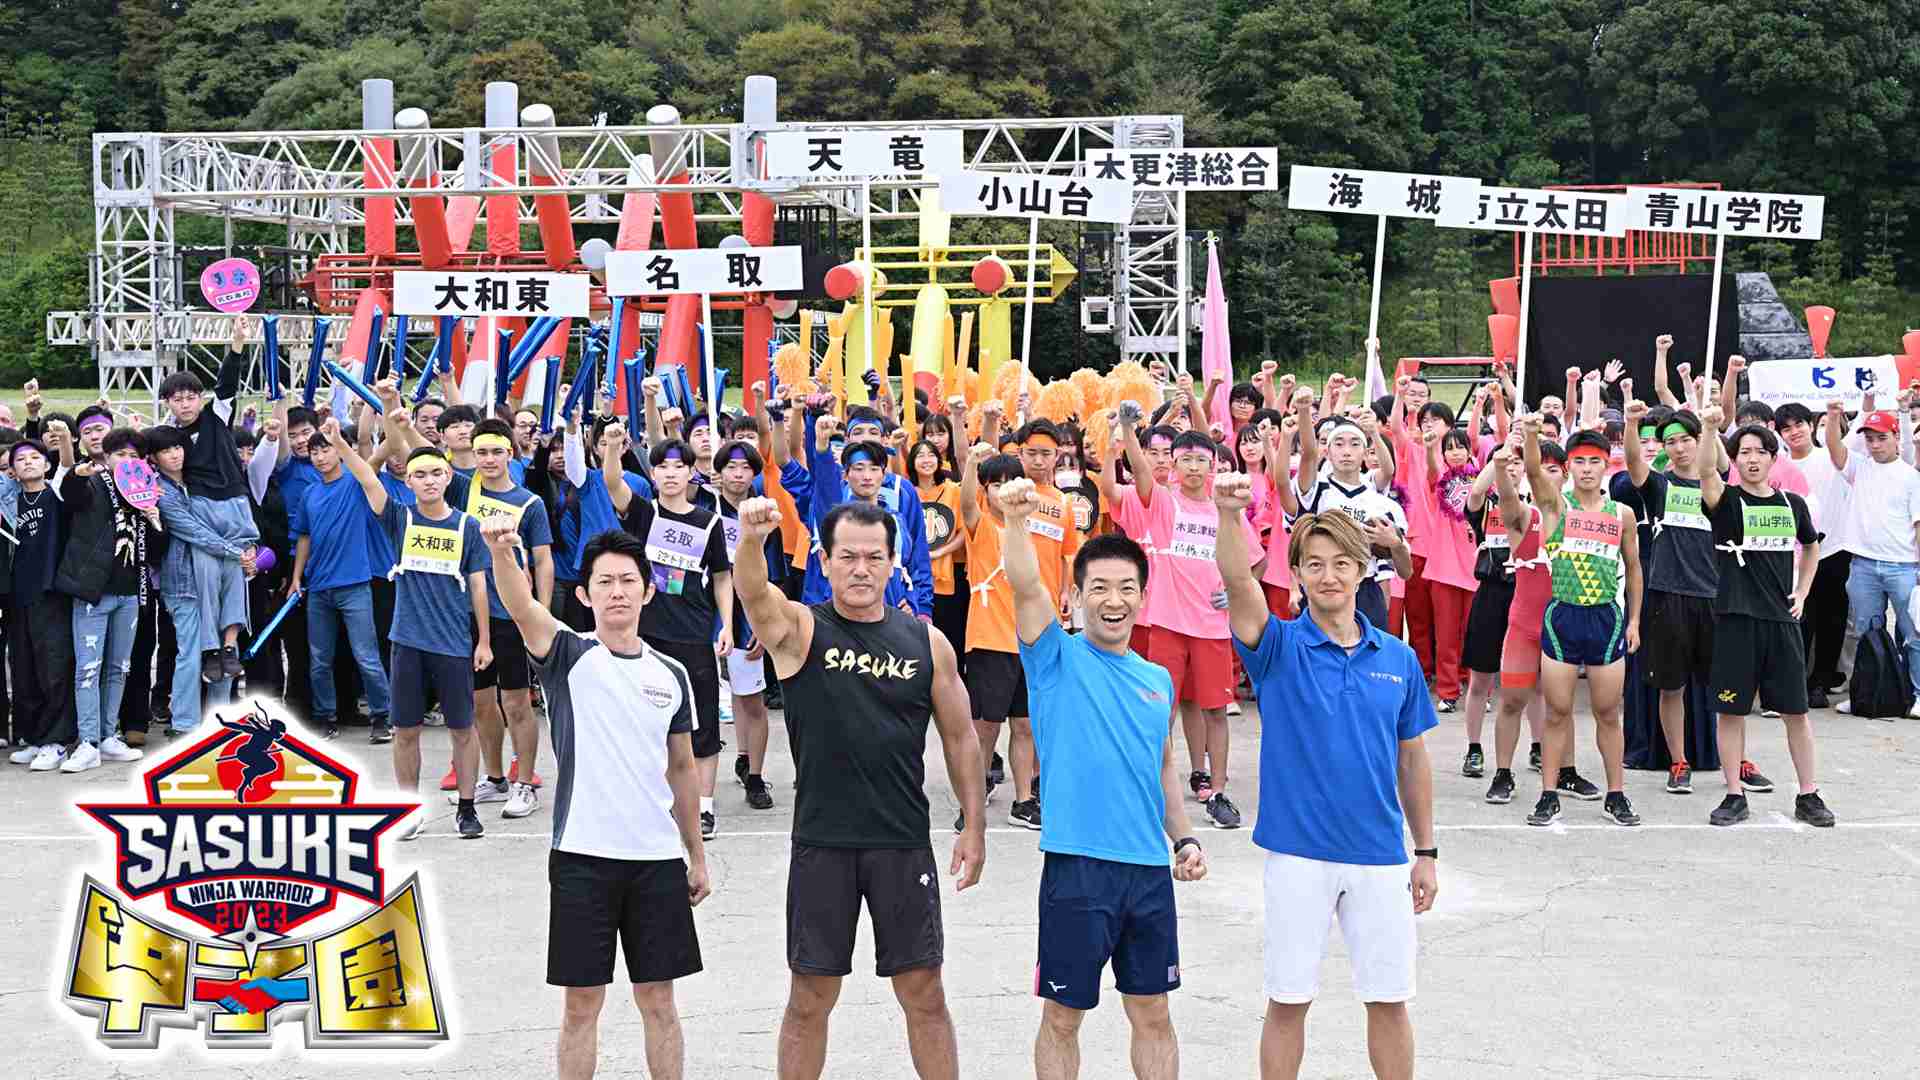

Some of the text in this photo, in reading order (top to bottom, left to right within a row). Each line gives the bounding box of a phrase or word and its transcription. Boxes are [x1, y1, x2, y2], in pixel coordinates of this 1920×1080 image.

[1094, 152, 1270, 187] 木更津総合
[978, 176, 1094, 216] 小山台
[1645, 192, 1803, 234] 青山学院
[434, 276, 550, 313] 大和東
[1038, 502, 1062, 519] 山台
[1175, 521, 1217, 539] 木更津総
[1569, 517, 1619, 537] 市立太田
[1748, 514, 1793, 529] 青山学院
[411, 533, 457, 553] 大和東
[663, 527, 695, 548] 名取
[725, 527, 737, 542] 名
[824, 647, 921, 680] SASUKE
